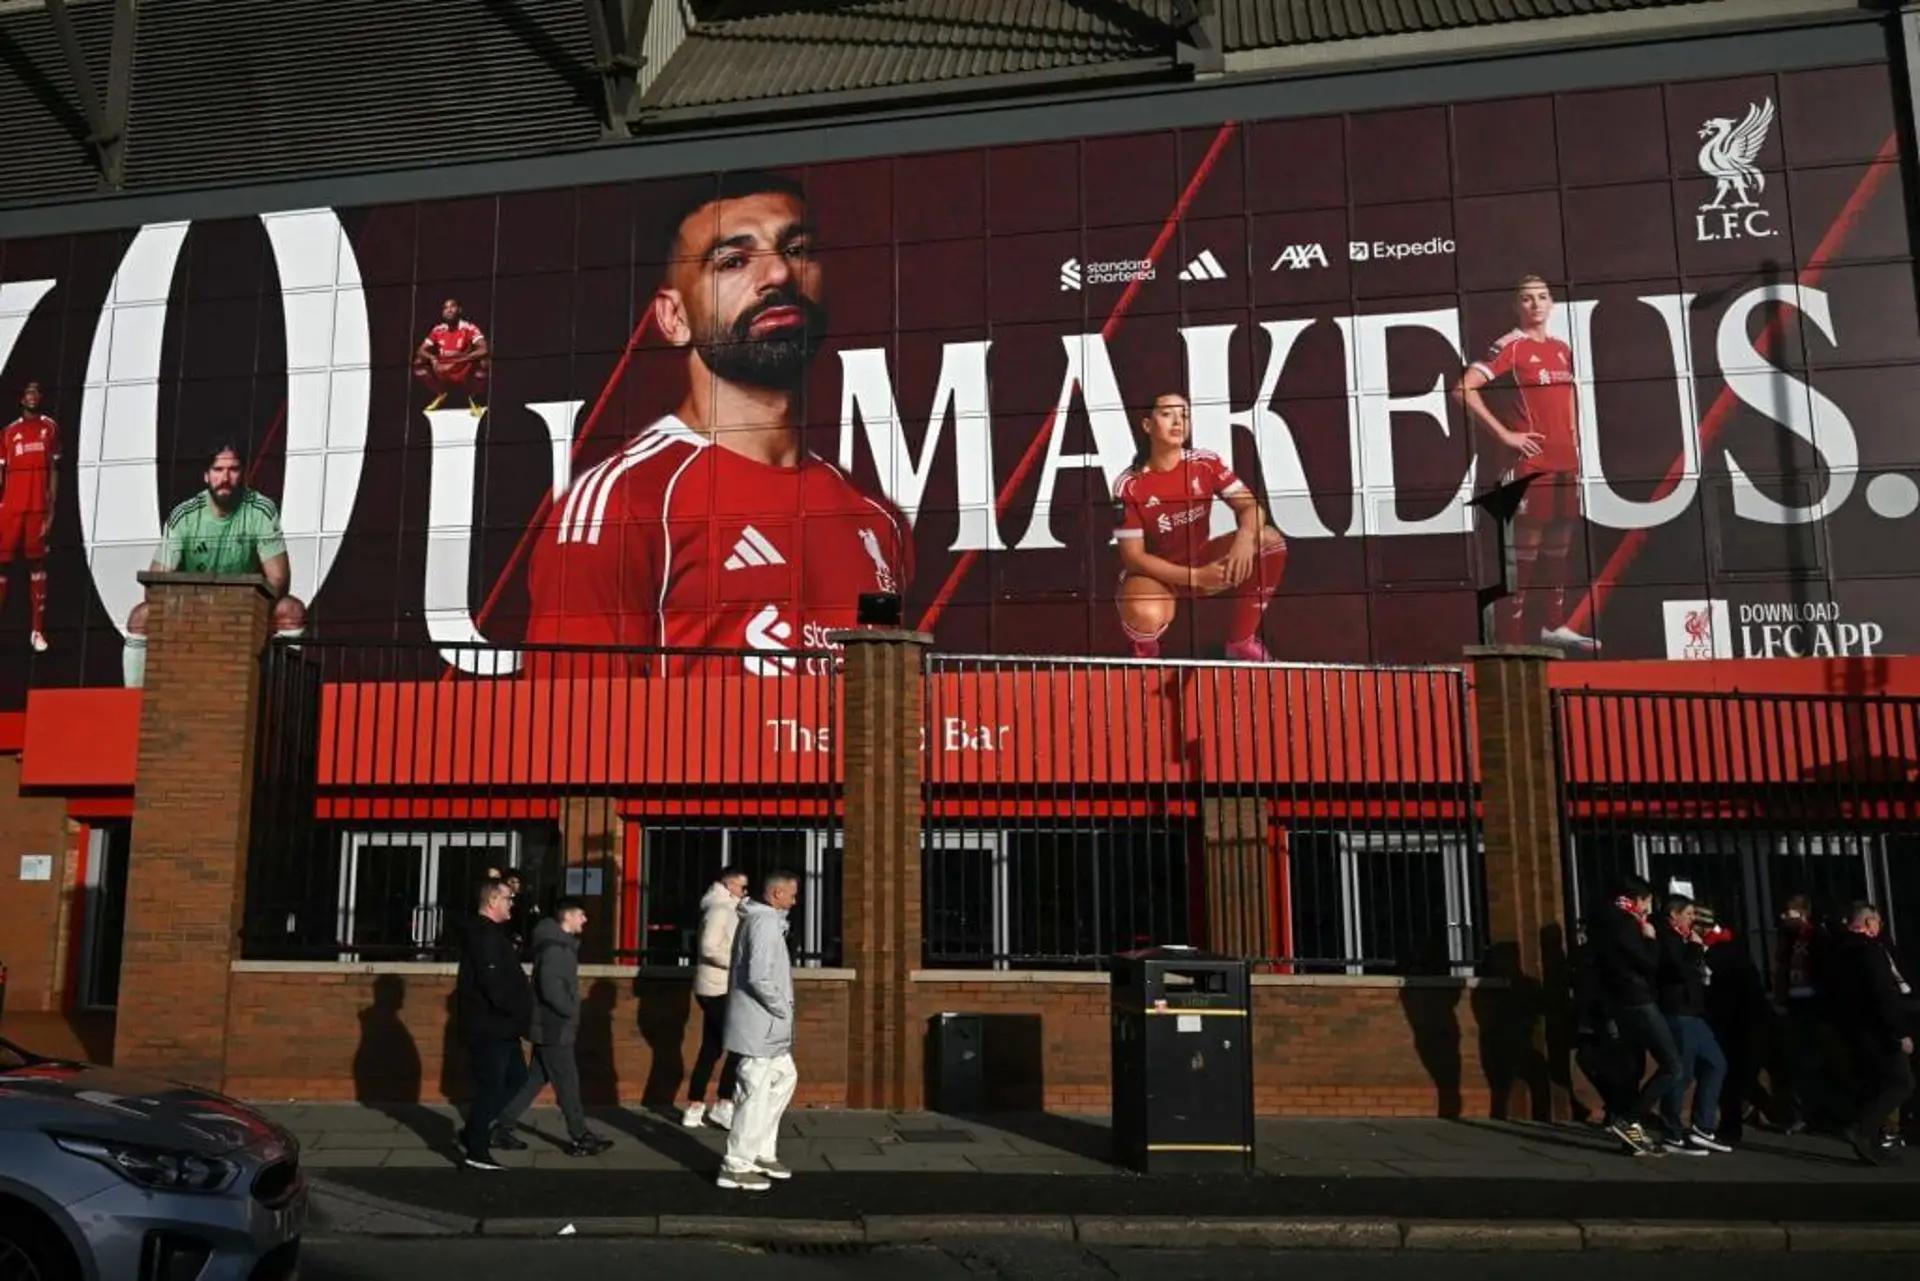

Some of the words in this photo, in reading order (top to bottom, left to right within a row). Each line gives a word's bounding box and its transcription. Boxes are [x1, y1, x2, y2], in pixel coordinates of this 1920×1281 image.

[1696, 210, 1778, 240] L.F.C.
[1270, 243, 1329, 271] AXA
[1373, 237, 1455, 260] Expedia
[1086, 258, 1153, 274] standard
[1086, 268, 1156, 285] chartered
[838, 308, 1478, 553] MAKE
[1547, 284, 1920, 530] US.
[1739, 601, 1840, 624] DOWNLOAD
[1741, 623, 1804, 659] LFC
[1811, 621, 1884, 658] APP
[766, 718, 831, 753] The
[944, 716, 1010, 752] Bar
